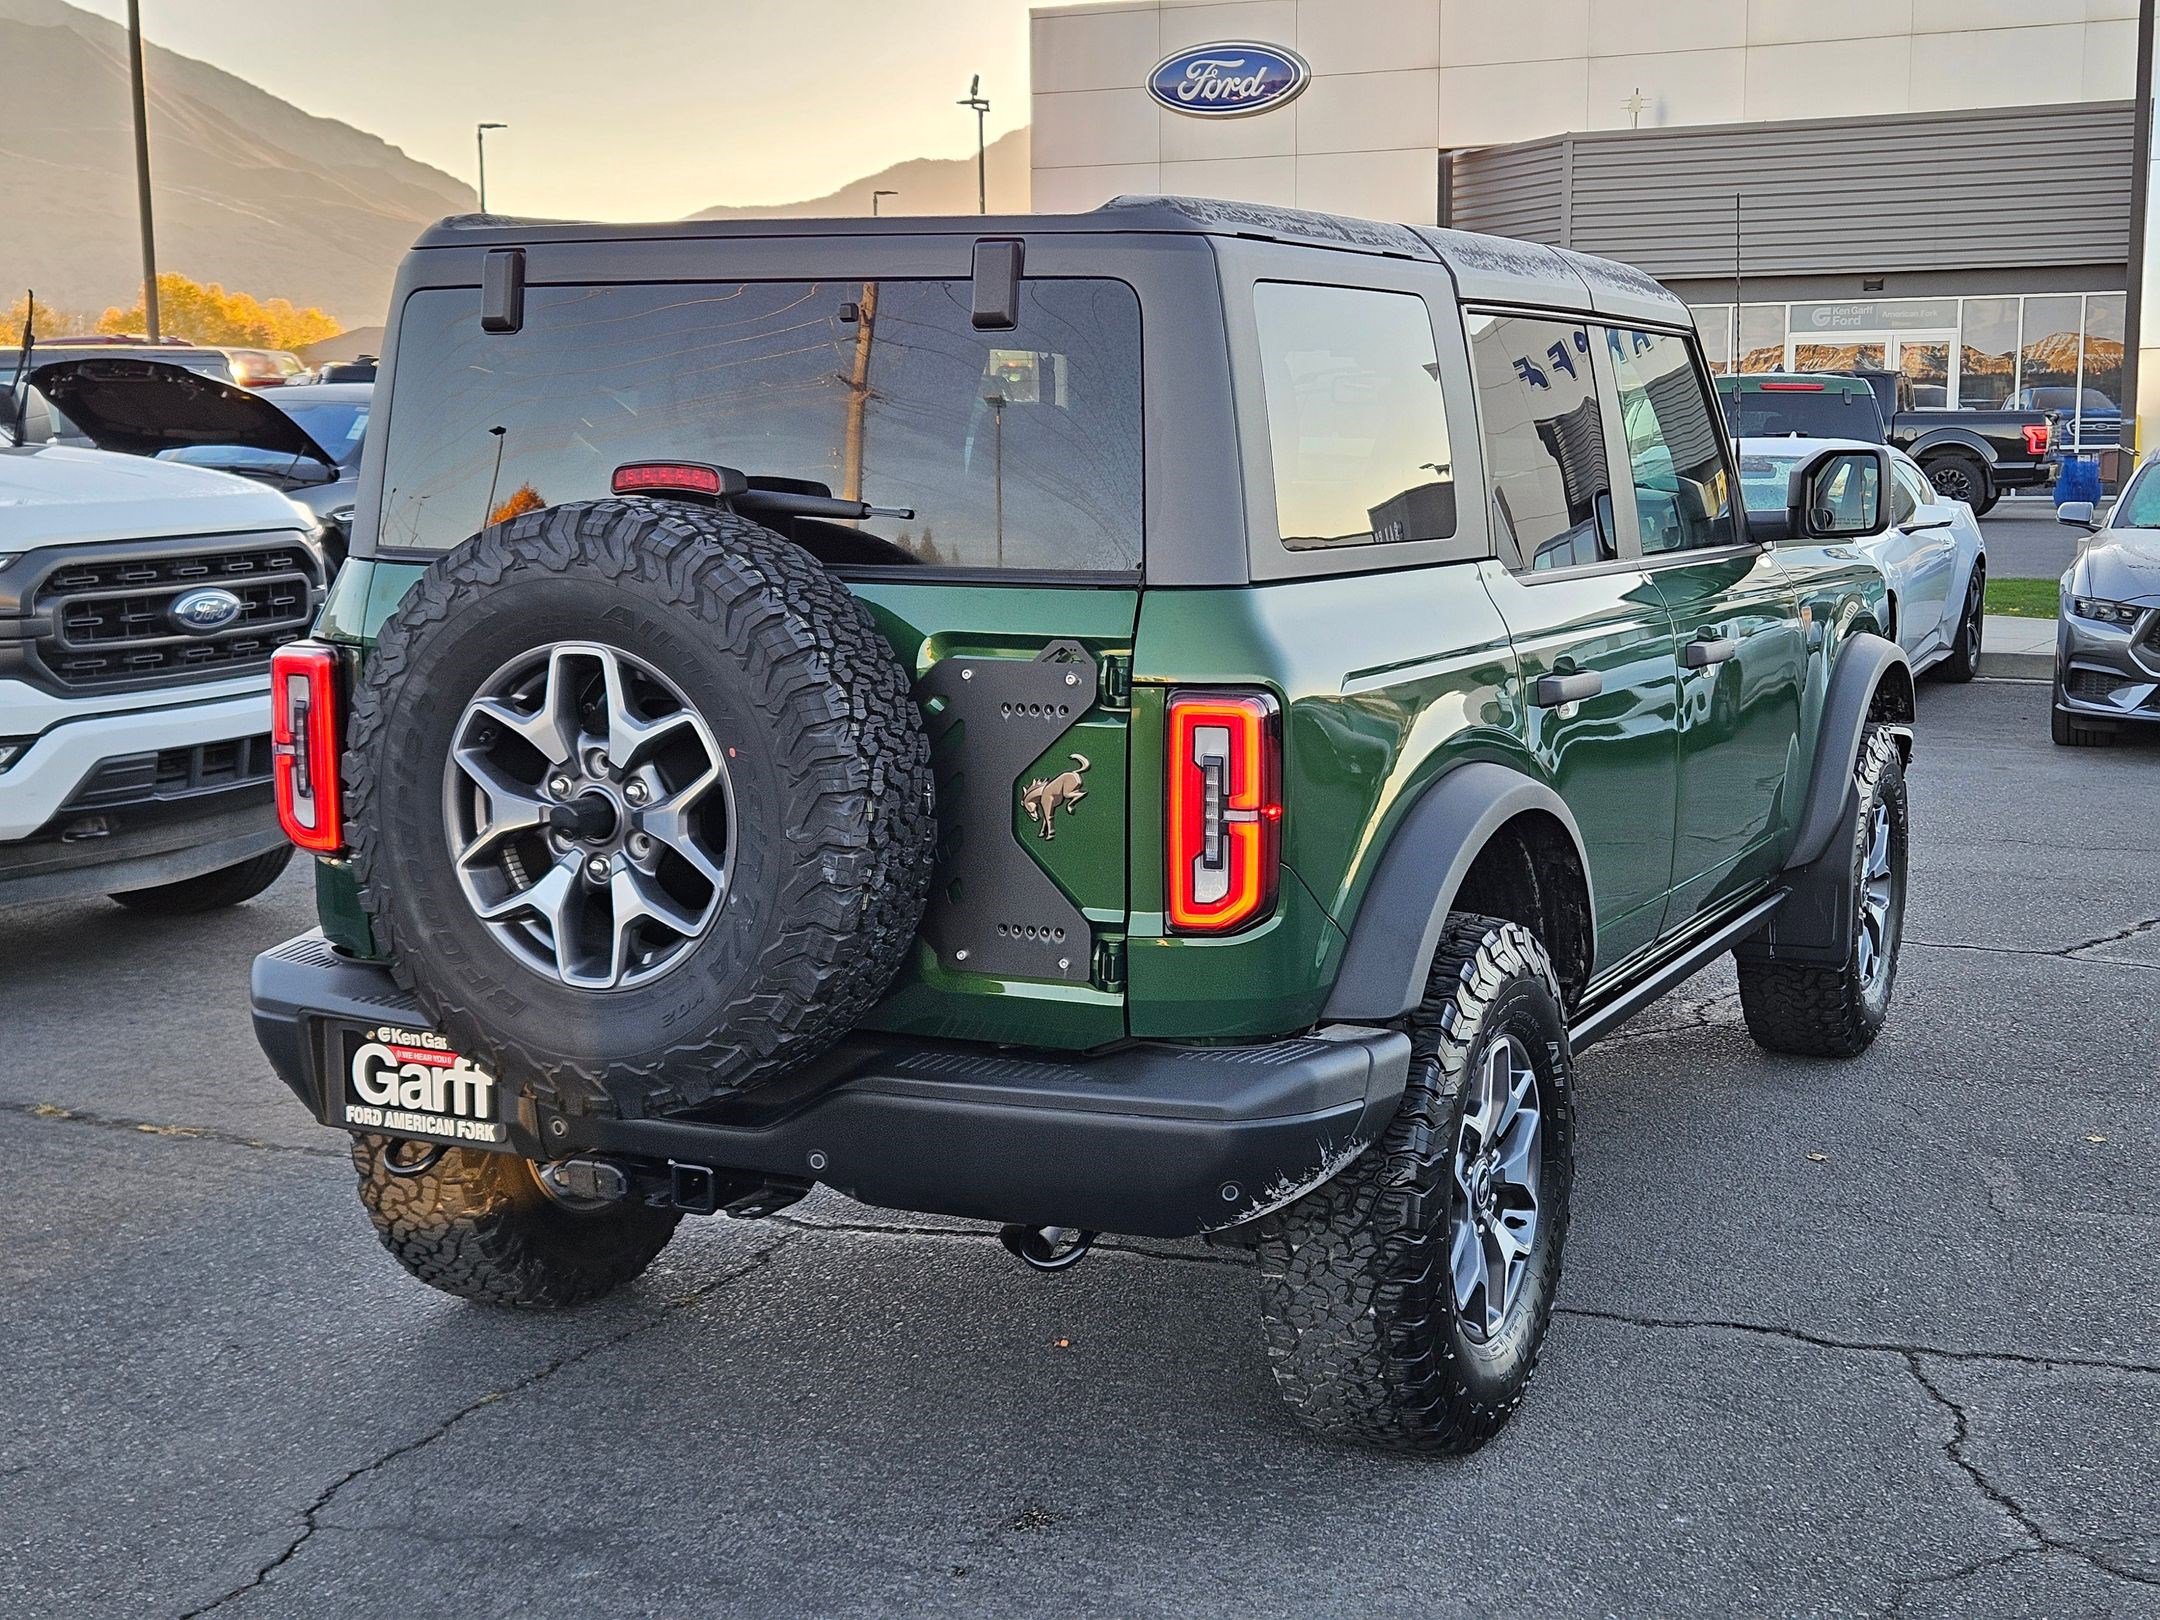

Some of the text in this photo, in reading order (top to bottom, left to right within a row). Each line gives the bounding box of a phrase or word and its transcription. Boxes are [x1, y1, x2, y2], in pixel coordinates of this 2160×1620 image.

[1178, 58, 1267, 100] Ford
[1832, 305, 1873, 315] Ken Garff
[1832, 315, 1861, 325] Ford
[194, 600, 226, 620] Ford
[391, 1027, 450, 1050] Ken Gar
[402, 1051, 413, 1059] WE
[414, 1053, 432, 1061] HEAR
[346, 1106, 495, 1142] FORD AMERICAN FORK
